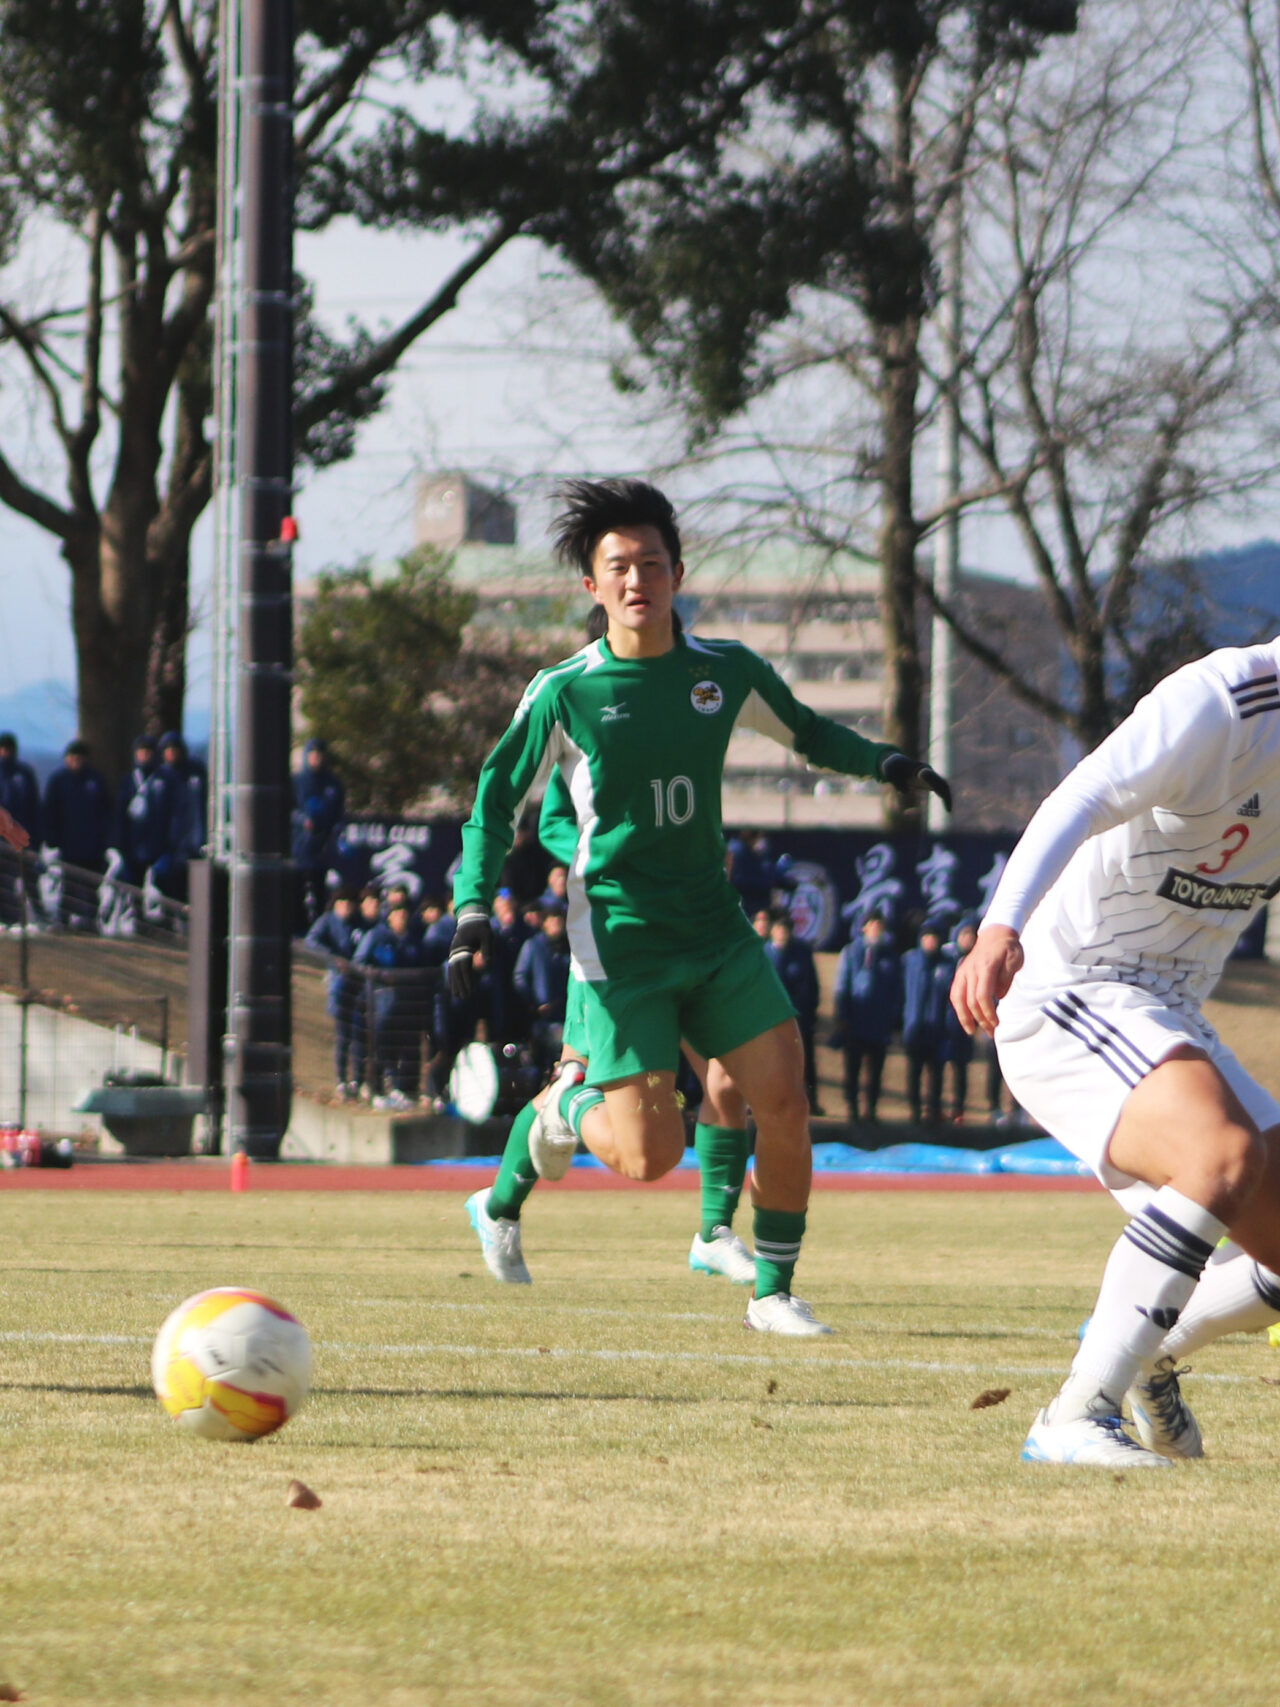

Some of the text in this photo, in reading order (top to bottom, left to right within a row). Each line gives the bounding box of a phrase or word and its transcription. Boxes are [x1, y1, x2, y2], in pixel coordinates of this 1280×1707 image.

[650, 775, 694, 827] 10
[1197, 823, 1250, 874] 3
[1171, 875, 1216, 905] TOYO
